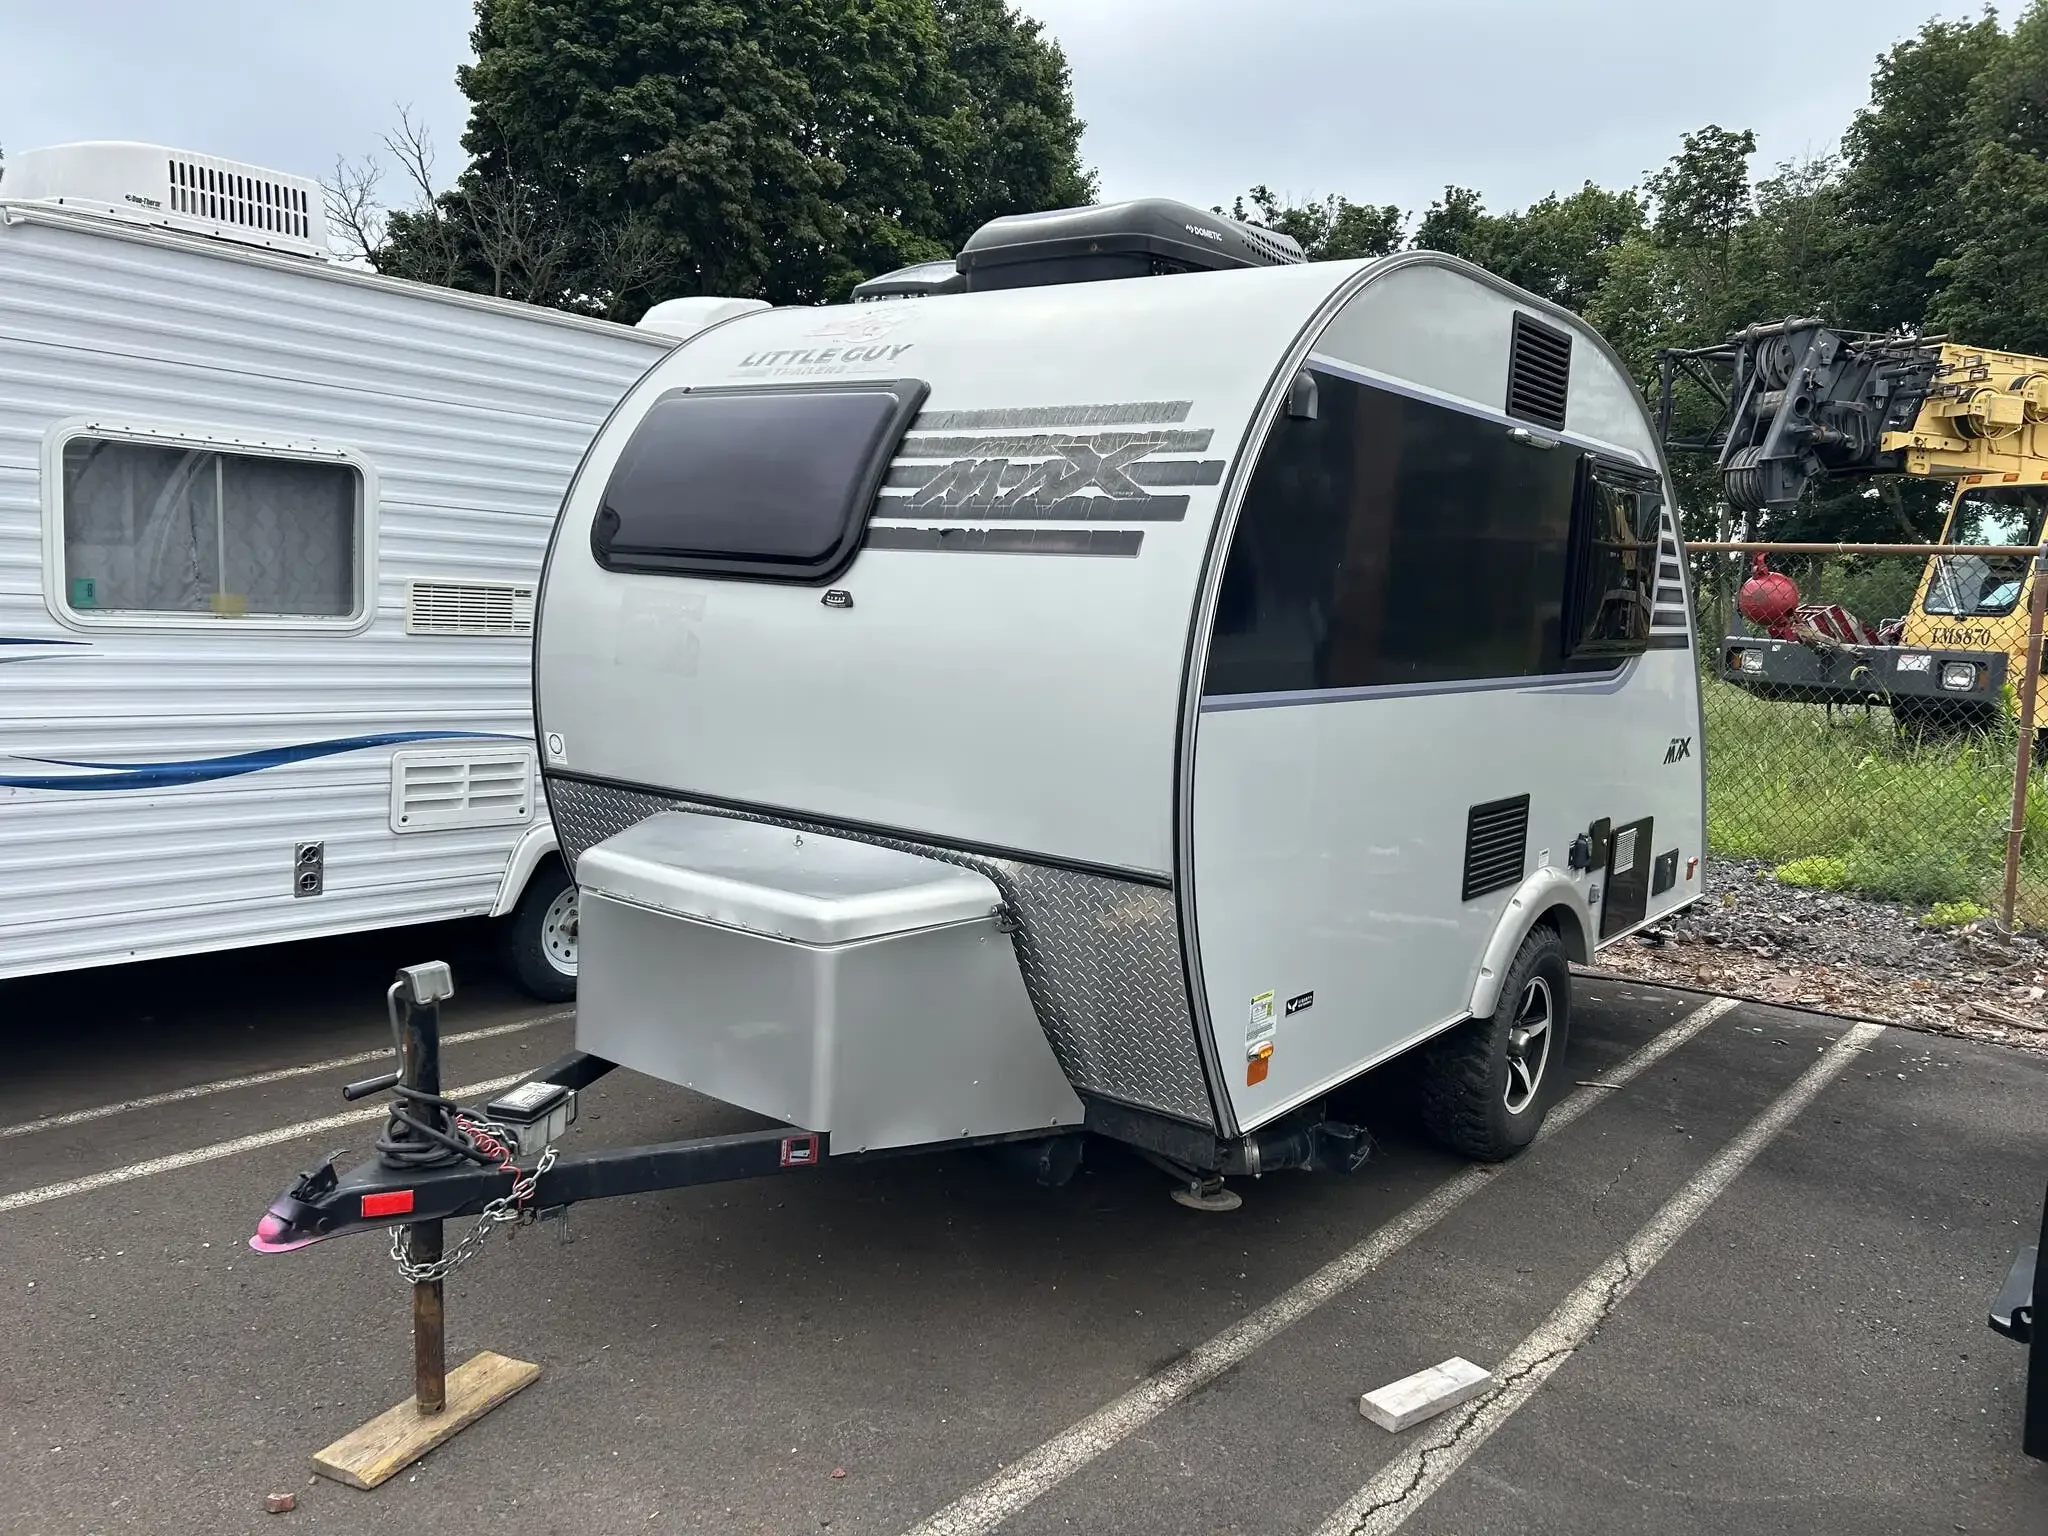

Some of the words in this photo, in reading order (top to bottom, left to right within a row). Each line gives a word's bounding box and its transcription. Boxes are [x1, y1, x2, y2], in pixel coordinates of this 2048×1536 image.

[1194, 226, 1222, 241] DOMETIC
[737, 348, 843, 367] LITTLE
[841, 343, 914, 363] GUY
[904, 441, 1168, 508] MAX
[1931, 627, 1990, 646] TMS870
[1663, 736, 1691, 765] MAX
